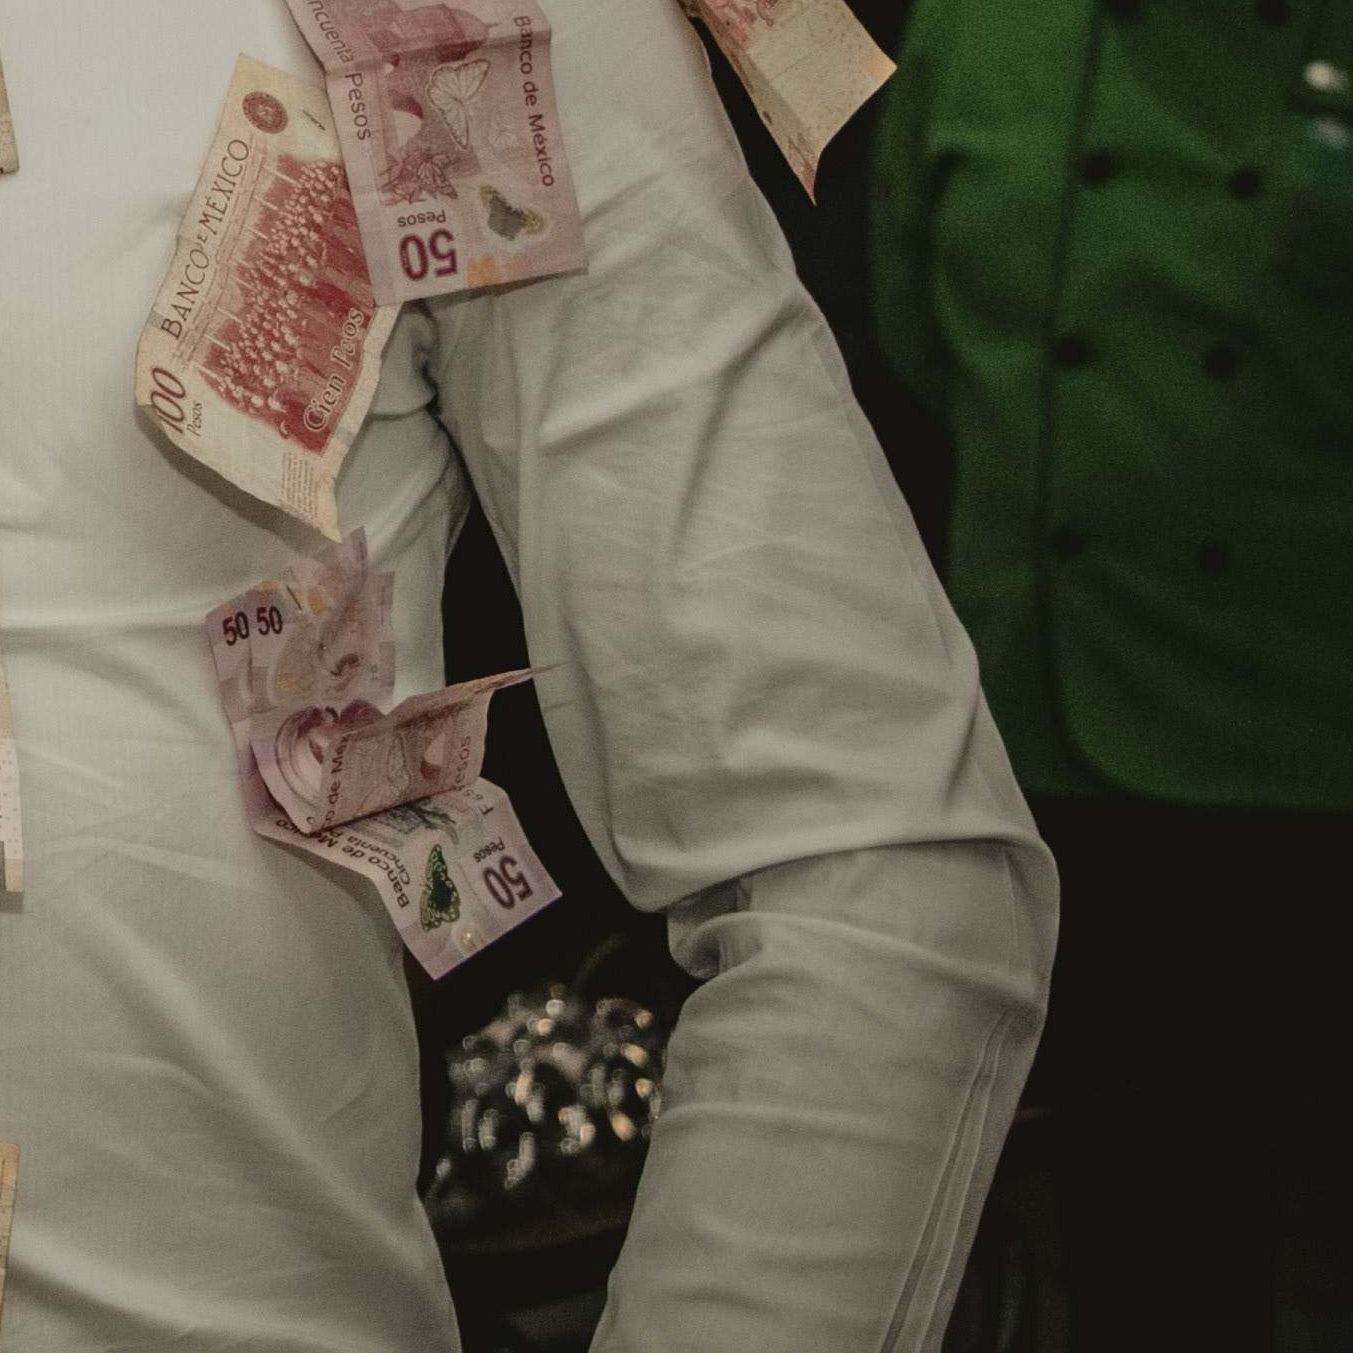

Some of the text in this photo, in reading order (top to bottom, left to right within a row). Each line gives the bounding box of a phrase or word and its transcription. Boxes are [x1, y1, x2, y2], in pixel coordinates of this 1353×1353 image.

[344, 72, 372, 142] Pesos
[513, 15, 556, 188] Banco de México
[161, 248, 210, 341] BANCO
[199, 139, 250, 236] MÉXICO
[397, 209, 447, 228] Pesos
[399, 228, 458, 282] 50
[151, 366, 187, 436] 100
[302, 373, 345, 432] Cien
[222, 611, 250, 646] 50
[256, 605, 284, 636] 50
[341, 846, 365, 859] de
[347, 835, 411, 886] Cincuenta
[473, 837, 506, 864] Pesos
[368, 856, 411, 908] Banco
[481, 855, 533, 910] 50
